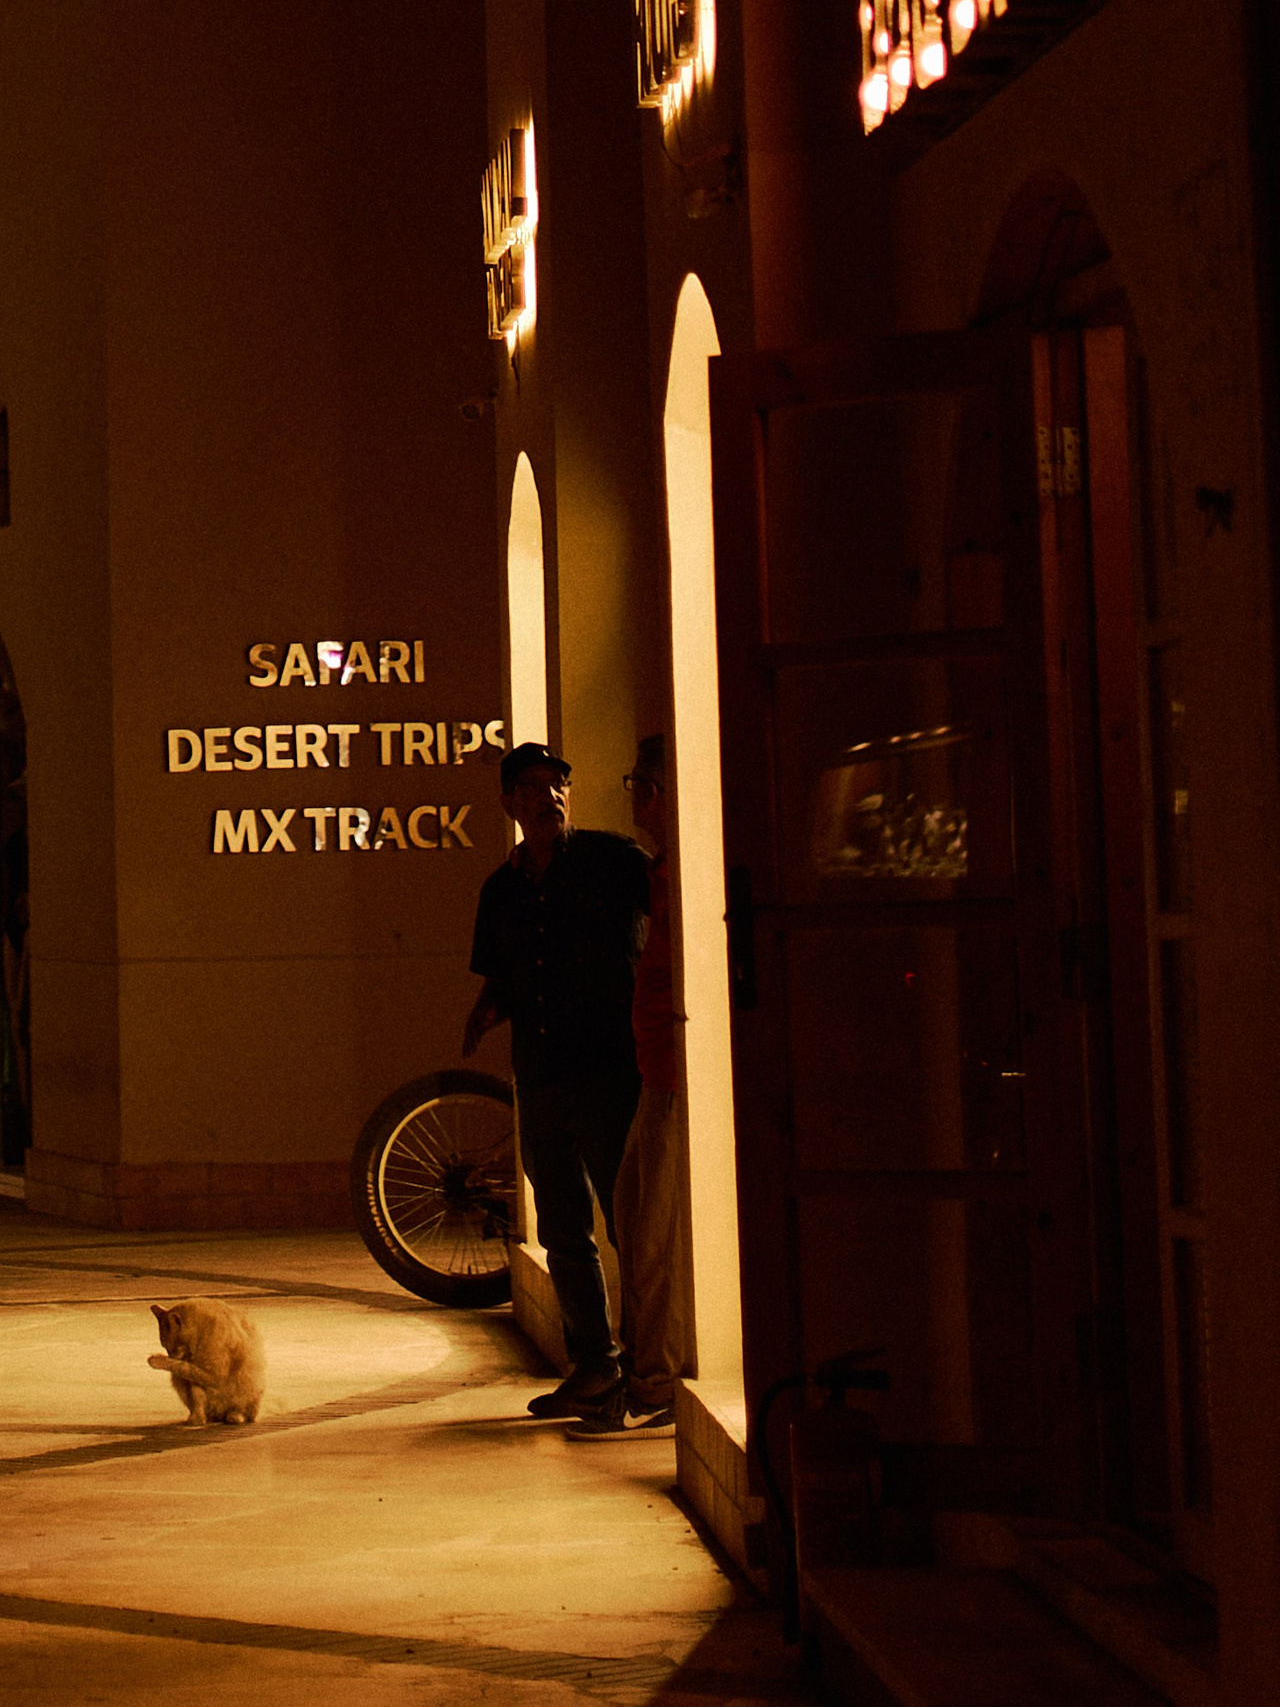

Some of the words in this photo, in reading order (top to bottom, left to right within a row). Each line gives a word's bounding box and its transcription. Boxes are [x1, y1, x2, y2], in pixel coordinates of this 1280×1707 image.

[248, 640, 425, 687] SAFARI
[167, 723, 360, 773] DESERT
[304, 804, 474, 851] TRACK
